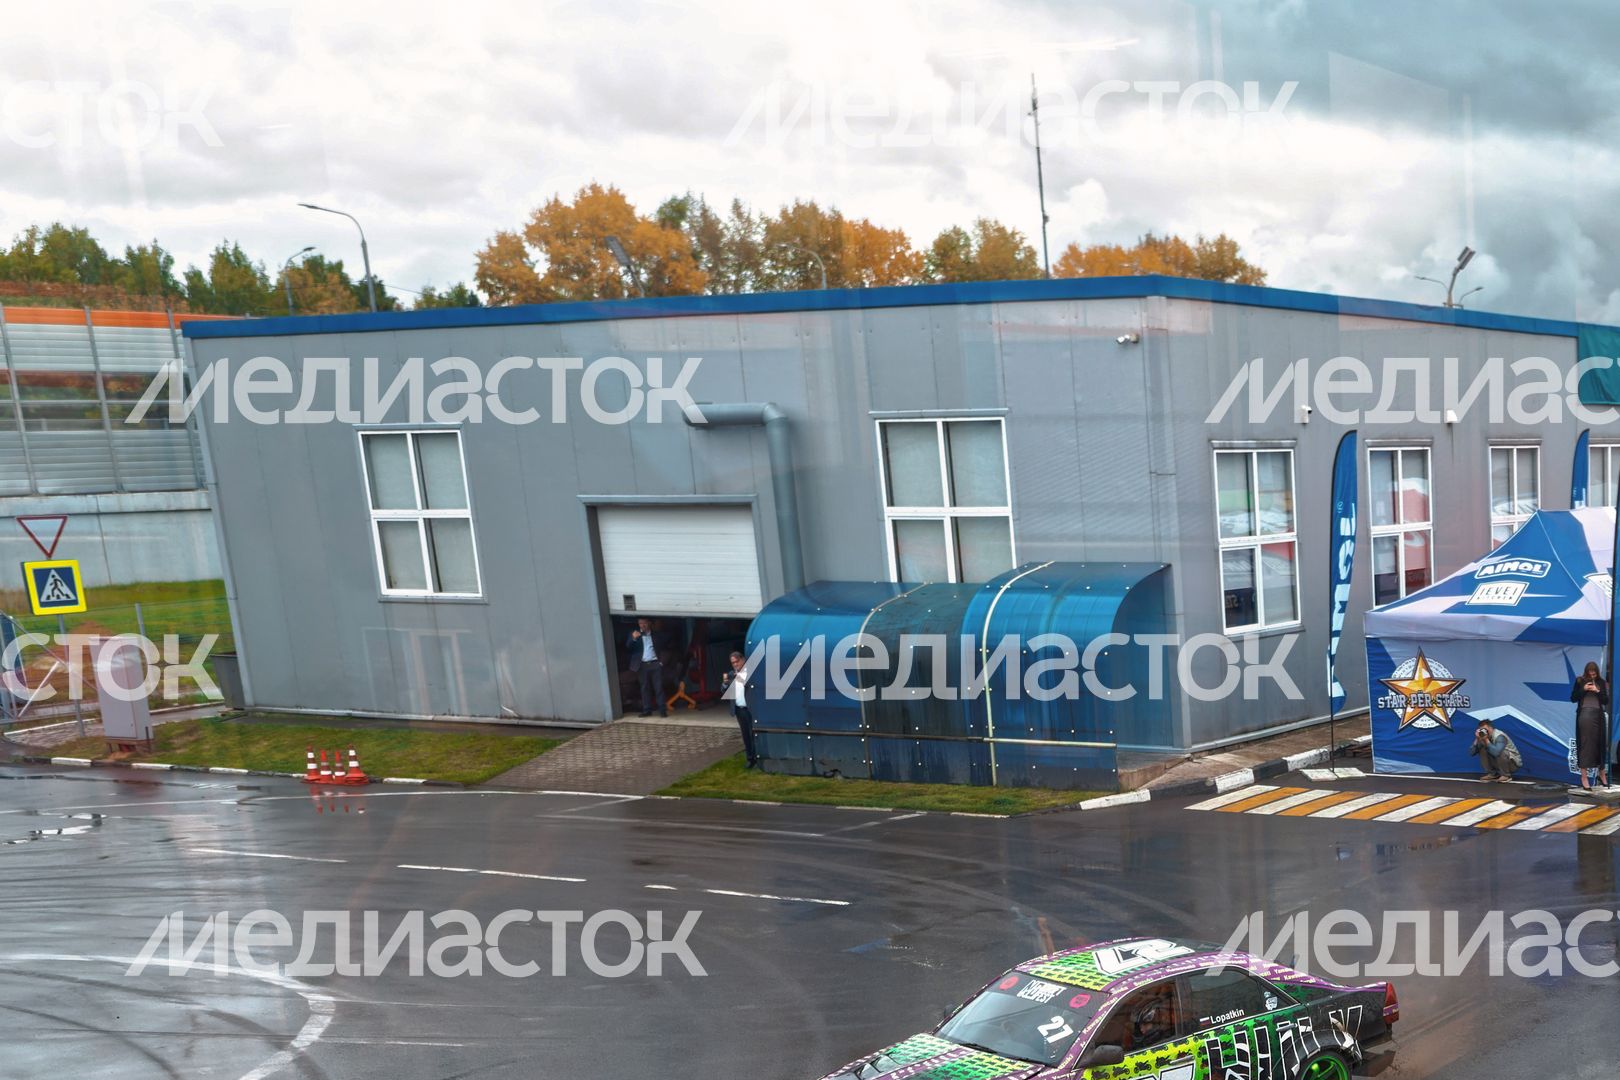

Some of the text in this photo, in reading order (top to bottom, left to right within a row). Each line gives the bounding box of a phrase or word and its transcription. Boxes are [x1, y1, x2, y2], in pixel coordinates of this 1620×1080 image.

[1480, 561, 1545, 578] AIMOL
[1378, 692, 1471, 709] STAR PER STARS
[1210, 1007, 1245, 1024] Lopatkin
[1037, 1015, 1074, 1044] 27
